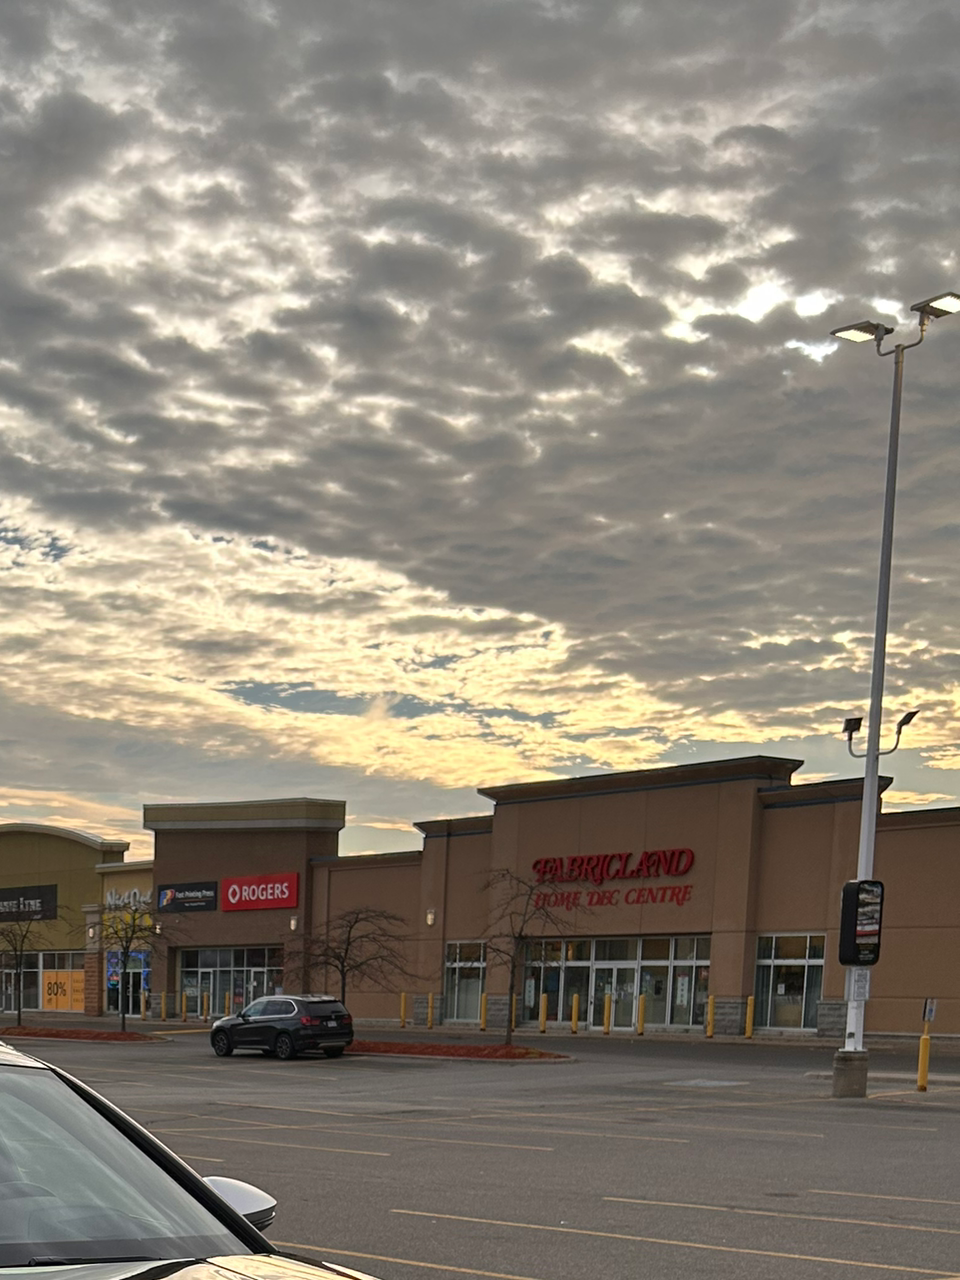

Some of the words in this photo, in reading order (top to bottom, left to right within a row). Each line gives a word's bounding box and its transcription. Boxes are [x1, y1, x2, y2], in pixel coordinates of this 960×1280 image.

[532, 849, 695, 885] FABRICLAND
[242, 882, 289, 901] ROGERS
[534, 891, 581, 911] HOME
[624, 885, 693, 906] CENTRE
[47, 982, 66, 996] 80%
